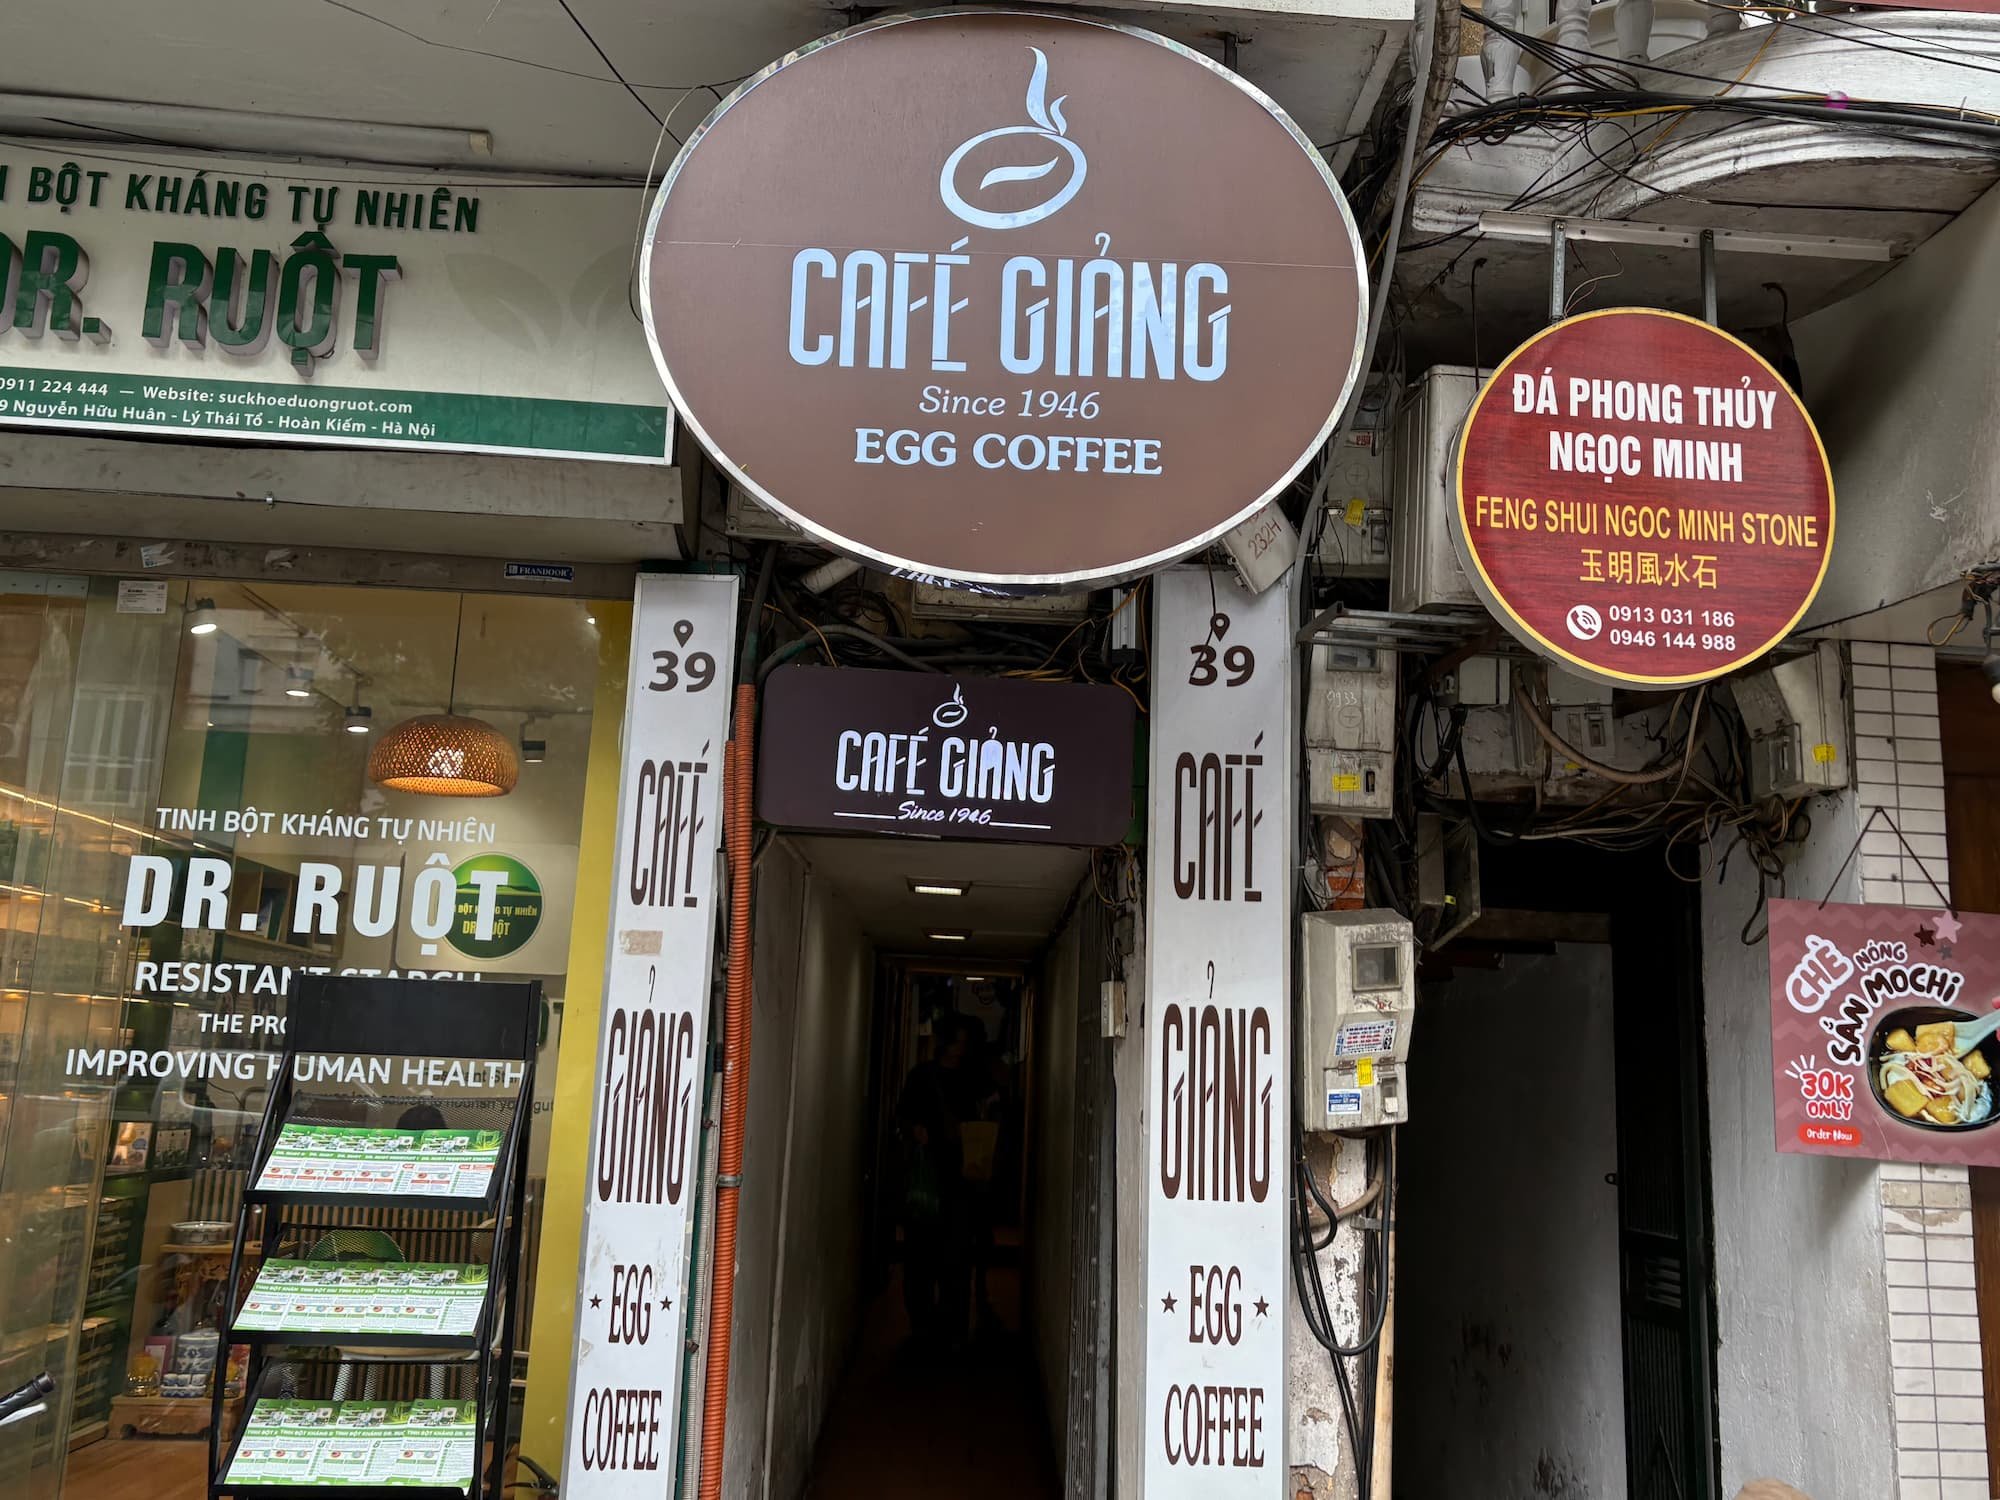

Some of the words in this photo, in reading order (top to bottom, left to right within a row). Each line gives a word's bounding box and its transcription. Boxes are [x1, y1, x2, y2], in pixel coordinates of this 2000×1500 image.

[28, 162, 108, 212] BỘT
[125, 169, 268, 219] KHÁNG
[288, 186, 340, 231] TỰ
[355, 187, 480, 233] NHIÊN
[0, 229, 112, 341] R.
[142, 231, 400, 370] RUỘT
[788, 235, 970, 372] CAFÉ
[1000, 232, 1231, 382] GIẢNG
[13, 400, 77, 418] Nguyễn
[83, 404, 117, 418] Hữu
[123, 406, 166, 421] Huân
[182, 410, 200, 426] Lý
[205, 411, 240, 425] Thái
[244, 413, 263, 427] Tổ
[278, 416, 320, 430] Hoàn
[326, 418, 366, 433] Kiếm
[382, 421, 403, 435] Hà
[408, 423, 436, 439] Nội
[42, 380, 72, 394] 224
[77, 382, 108, 397] 444
[143, 385, 214, 403] Website:
[218, 391, 413, 414] suckhoeduongruot.com
[918, 384, 1006, 416] Since
[1018, 389, 1100, 420] 1946
[1512, 367, 1558, 416] ĐÁ
[1569, 377, 1683, 425] PHONG
[1693, 375, 1777, 430] THỦY
[854, 427, 957, 466] EGG
[972, 432, 1163, 476] COFFEE
[1549, 430, 1641, 484] NGỌC
[1653, 437, 1743, 482] MINH
[1475, 495, 1538, 531] FENG
[1545, 500, 1598, 536] SHUI
[1605, 504, 1671, 540] NGOC
[1678, 509, 1735, 543] MINH
[1741, 512, 1818, 548] STONE
[1579, 548, 1718, 589] 玉明風水石
[1608, 605, 1654, 624] 0913
[1660, 607, 1694, 626] 031
[1701, 609, 1735, 628] 186
[1609, 629, 1656, 648] 0946
[1662, 631, 1696, 650] 144
[1701, 632, 1736, 651] 988
[648, 650, 716, 692] 39
[1188, 645, 1255, 687] 39
[835, 726, 929, 796] CAFÉ
[939, 726, 1056, 804] GIẢNG
[156, 807, 217, 832] TINH
[223, 806, 275, 838] BỘT
[280, 808, 370, 839] KHÁNG
[377, 817, 413, 845] TỰ
[417, 817, 496, 844] NHIÊN
[630, 738, 711, 908] CAFÉ
[898, 800, 945, 822] Since
[948, 807, 992, 826] 1946
[1173, 730, 1264, 902] CAFÉ
[122, 854, 258, 931] DR.
[292, 852, 509, 956] RUỘT
[1786, 935, 1854, 1013] CHÈ
[198, 1013, 244, 1034] THE
[65, 1048, 255, 1080] IMPROVING
[401, 1058, 525, 1088] HEALTH
[598, 965, 693, 1206] GIẢNG
[1160, 960, 1273, 1204] GIẢNG
[1801, 1069, 1853, 1099] 30K
[1807, 1101, 1852, 1119] ONLY
[1807, 1128, 1832, 1140] Order
[608, 1264, 654, 1346] EGG
[1189, 1264, 1242, 1346] EGG
[582, 1387, 662, 1472] COFFEE
[1164, 1384, 1265, 1468] COFFEE
